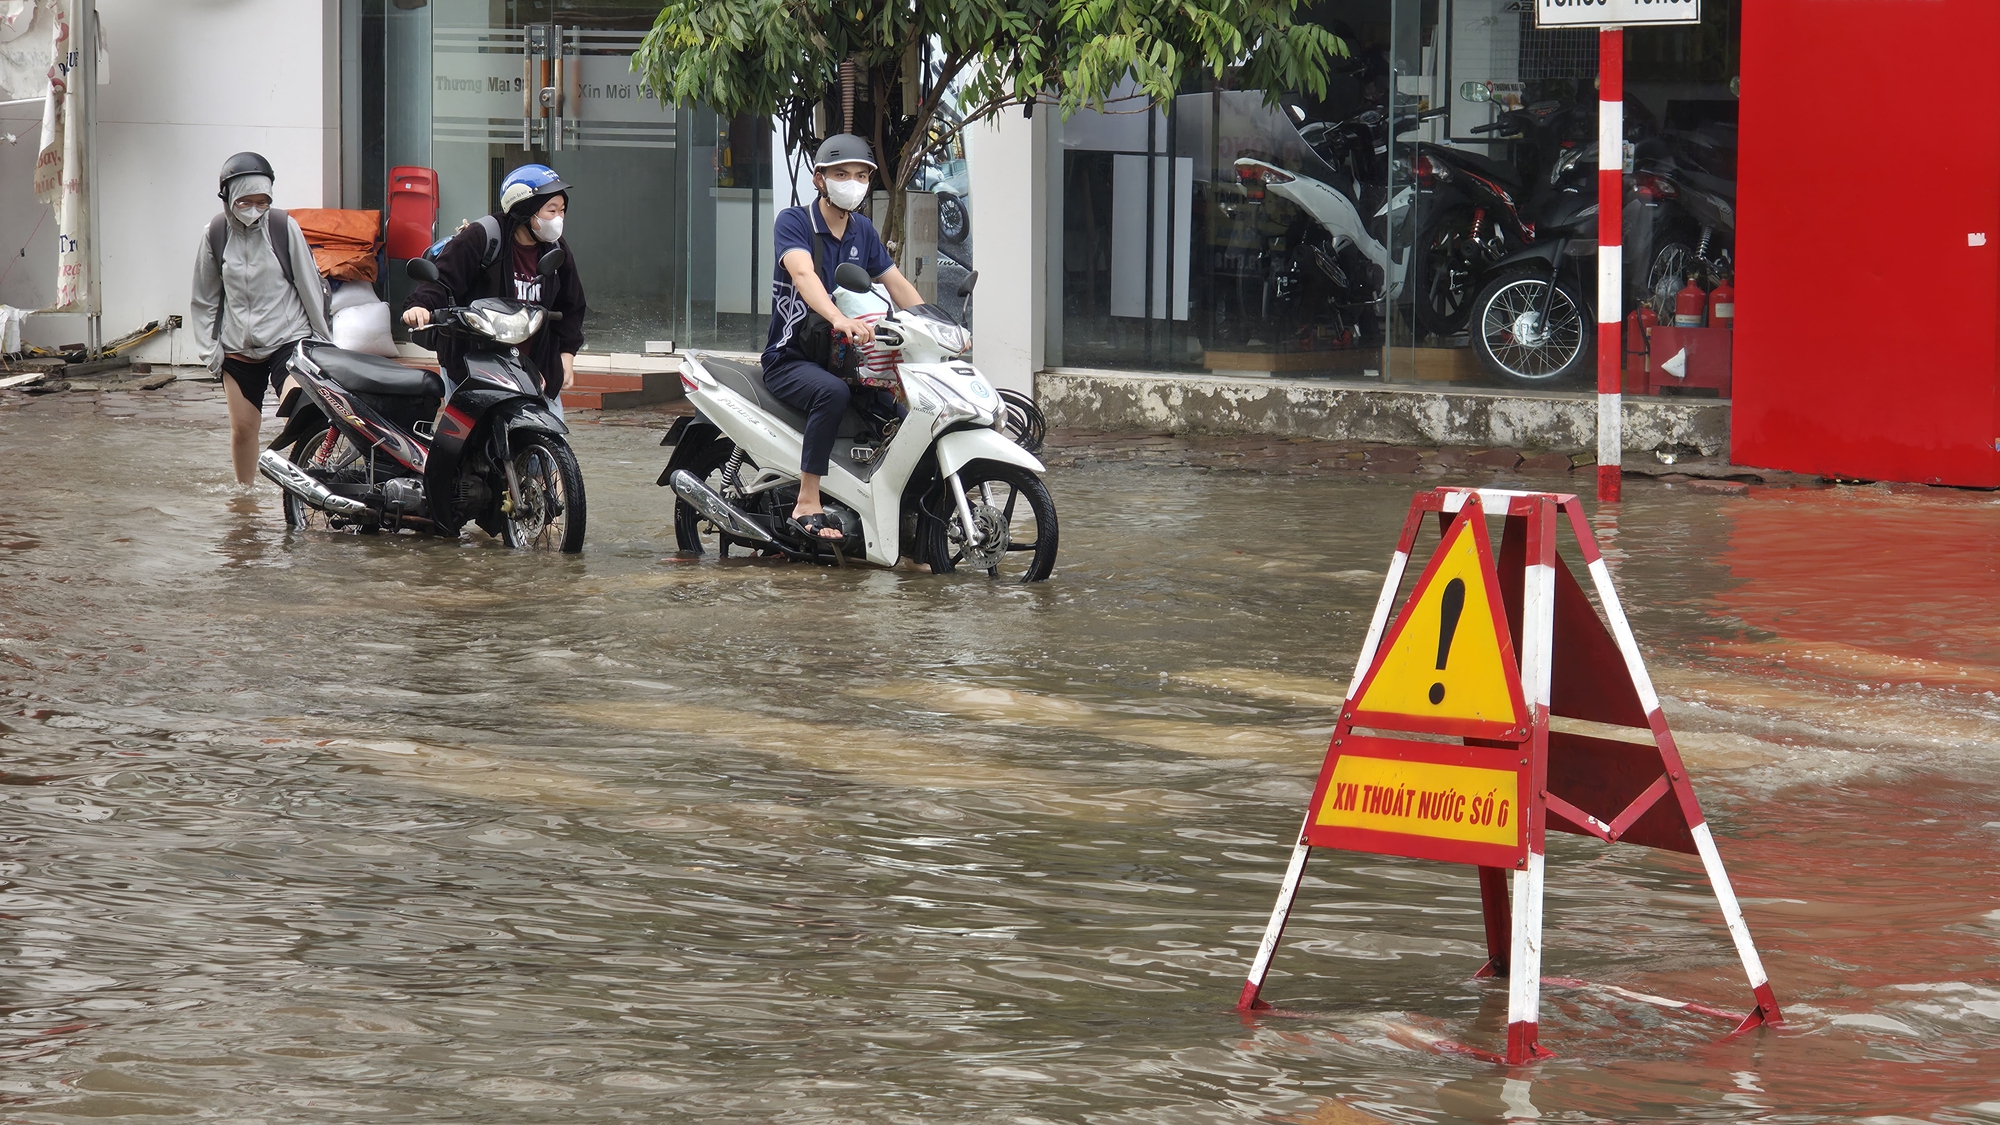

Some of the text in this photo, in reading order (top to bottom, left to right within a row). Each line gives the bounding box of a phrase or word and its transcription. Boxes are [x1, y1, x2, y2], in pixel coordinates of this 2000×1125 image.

[487, 77, 510, 95] Mại
[514, 77, 525, 93] 9
[578, 83, 601, 99] Xin
[606, 83, 631, 99] Mời
[60, 234, 79, 253] Tr
[913, 403, 935, 417] HONDA
[1333, 782, 1510, 828] XN THOÁT NƯỚC SỐ 6
